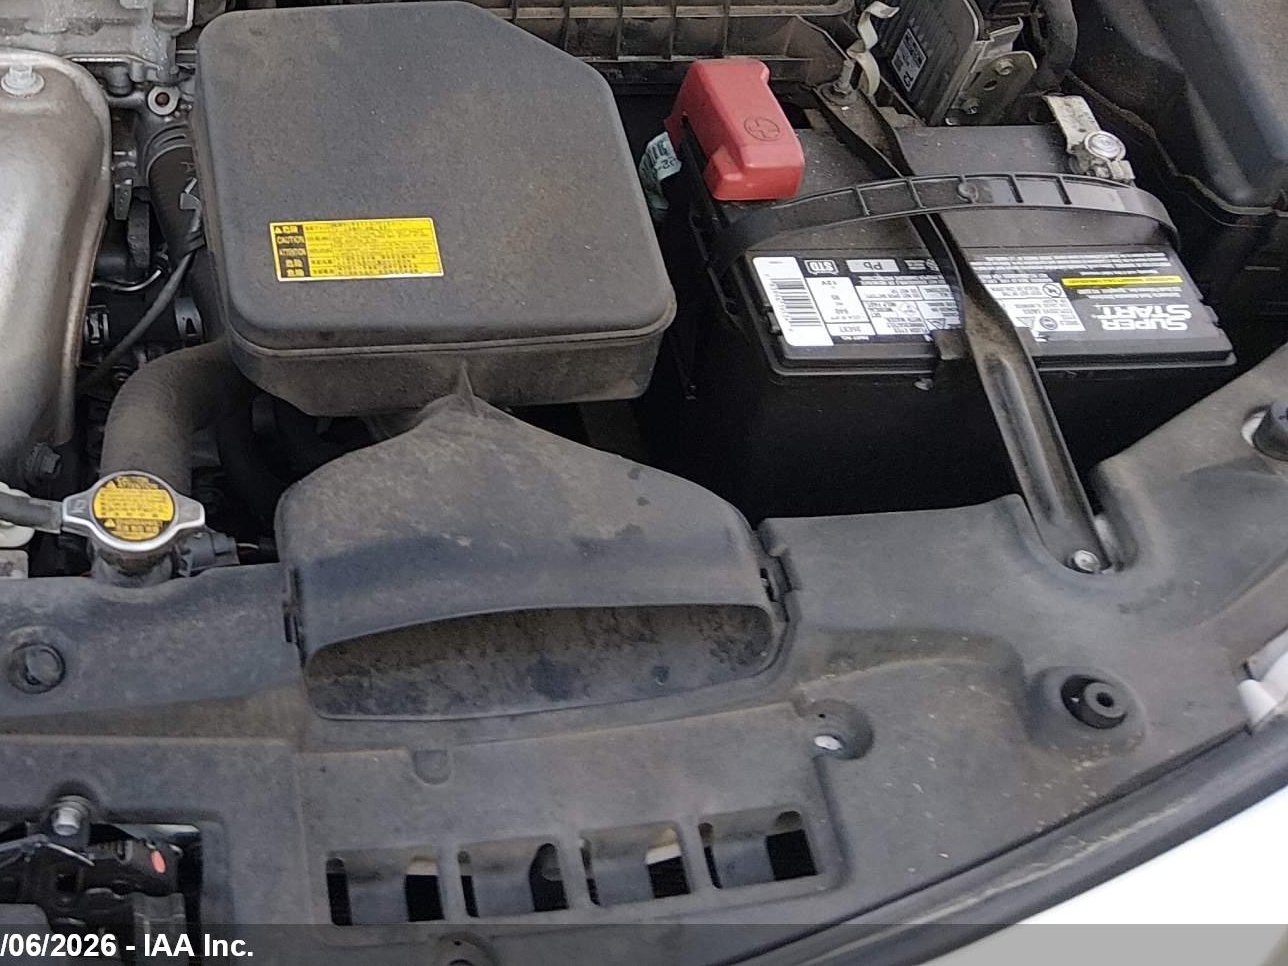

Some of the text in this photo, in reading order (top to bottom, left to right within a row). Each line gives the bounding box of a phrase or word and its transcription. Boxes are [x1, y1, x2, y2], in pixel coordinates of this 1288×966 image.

[809, 261, 834, 271] STD
[863, 262, 882, 271] Pb
[1094, 304, 1192, 319] START
[1100, 318, 1188, 331] SUPER
